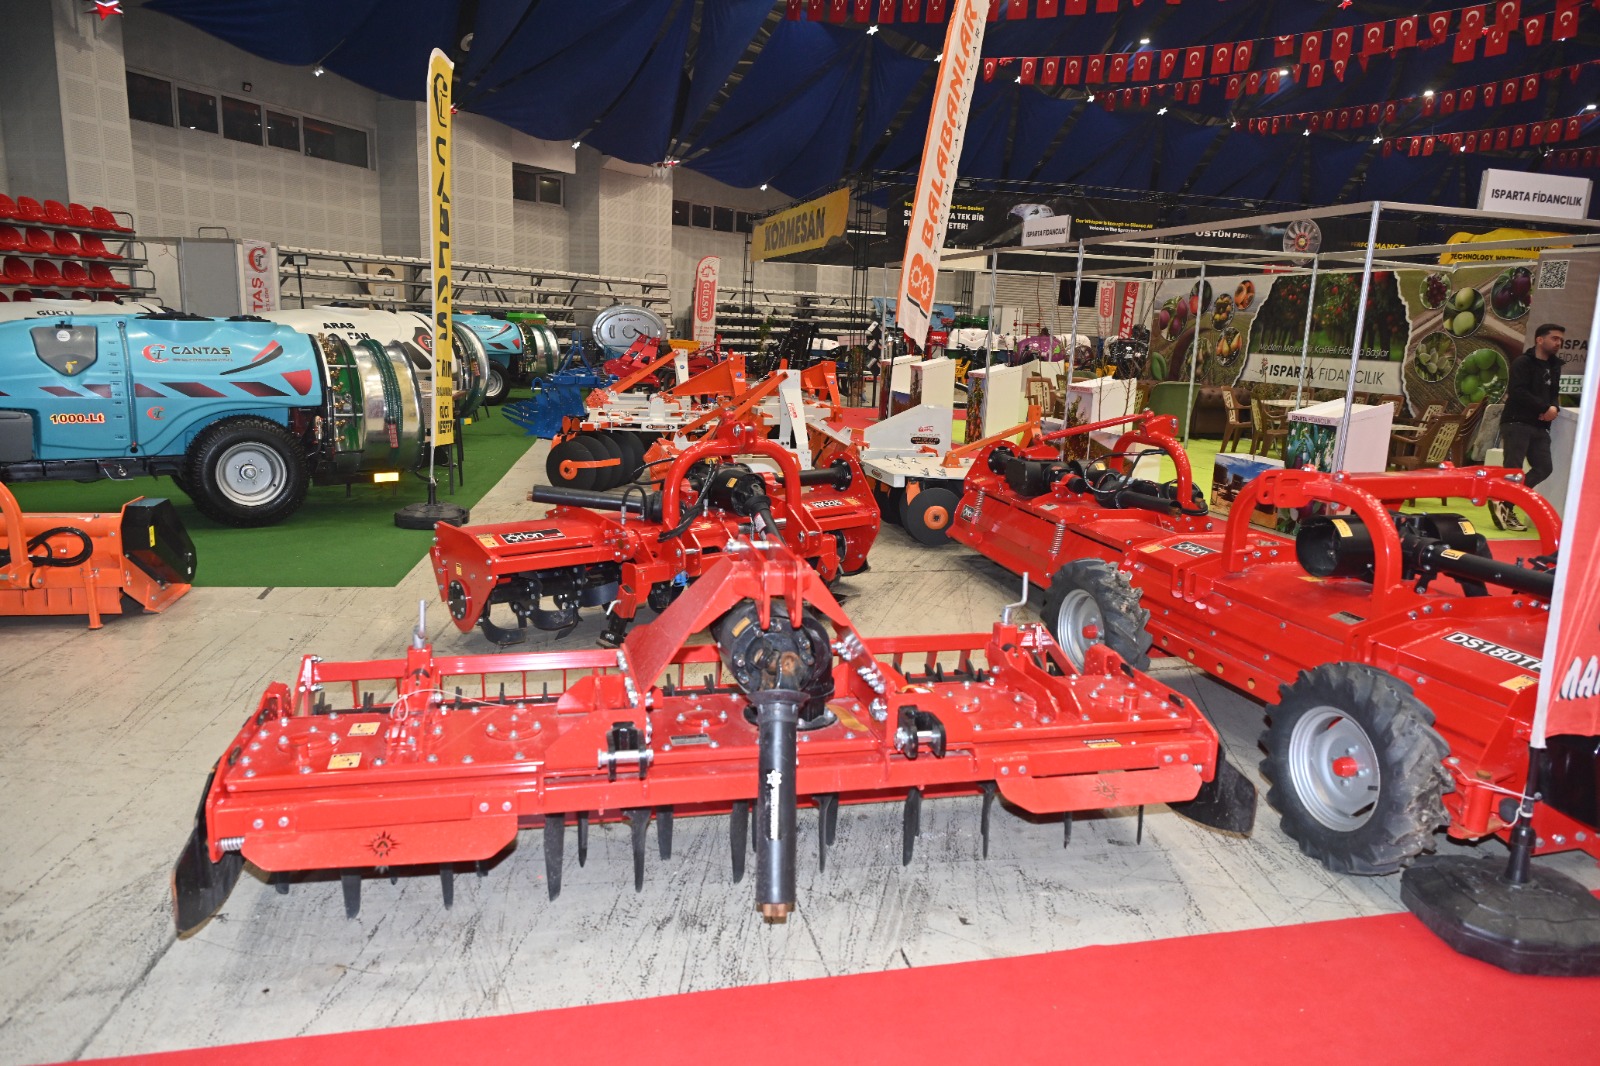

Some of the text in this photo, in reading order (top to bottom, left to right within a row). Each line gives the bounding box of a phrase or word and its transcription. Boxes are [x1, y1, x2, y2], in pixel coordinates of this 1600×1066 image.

[1491, 188, 1583, 206] ISPARTA FİDANCILIK
[957, 212, 971, 221] TEK
[971, 212, 984, 222] BİR
[764, 206, 826, 252] KORMESAN
[947, 222, 969, 230] ETER!
[701, 282, 710, 319] GÜLSAN
[171, 346, 231, 357] CANTAŞ
[50, 412, 105, 425] 1000.Lt
